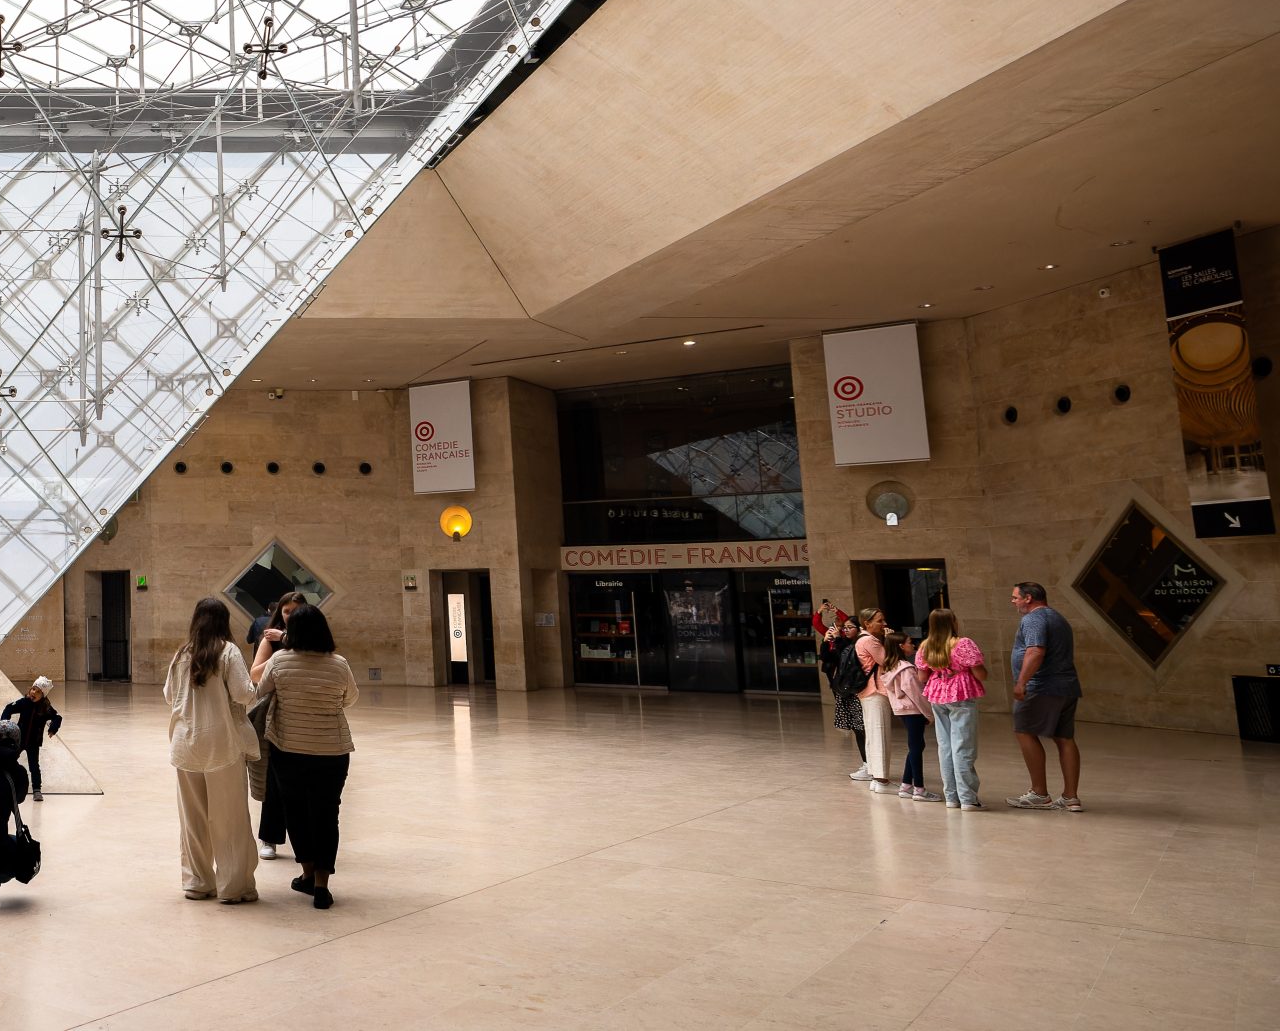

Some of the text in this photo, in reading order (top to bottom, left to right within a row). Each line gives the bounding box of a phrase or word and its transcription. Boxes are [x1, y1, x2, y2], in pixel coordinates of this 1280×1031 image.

[837, 406, 893, 419] STUDIO
[415, 440, 459, 452] COMÉDIE
[416, 449, 470, 462] FRANÇAISE
[1175, 579, 1213, 587] MAISON
